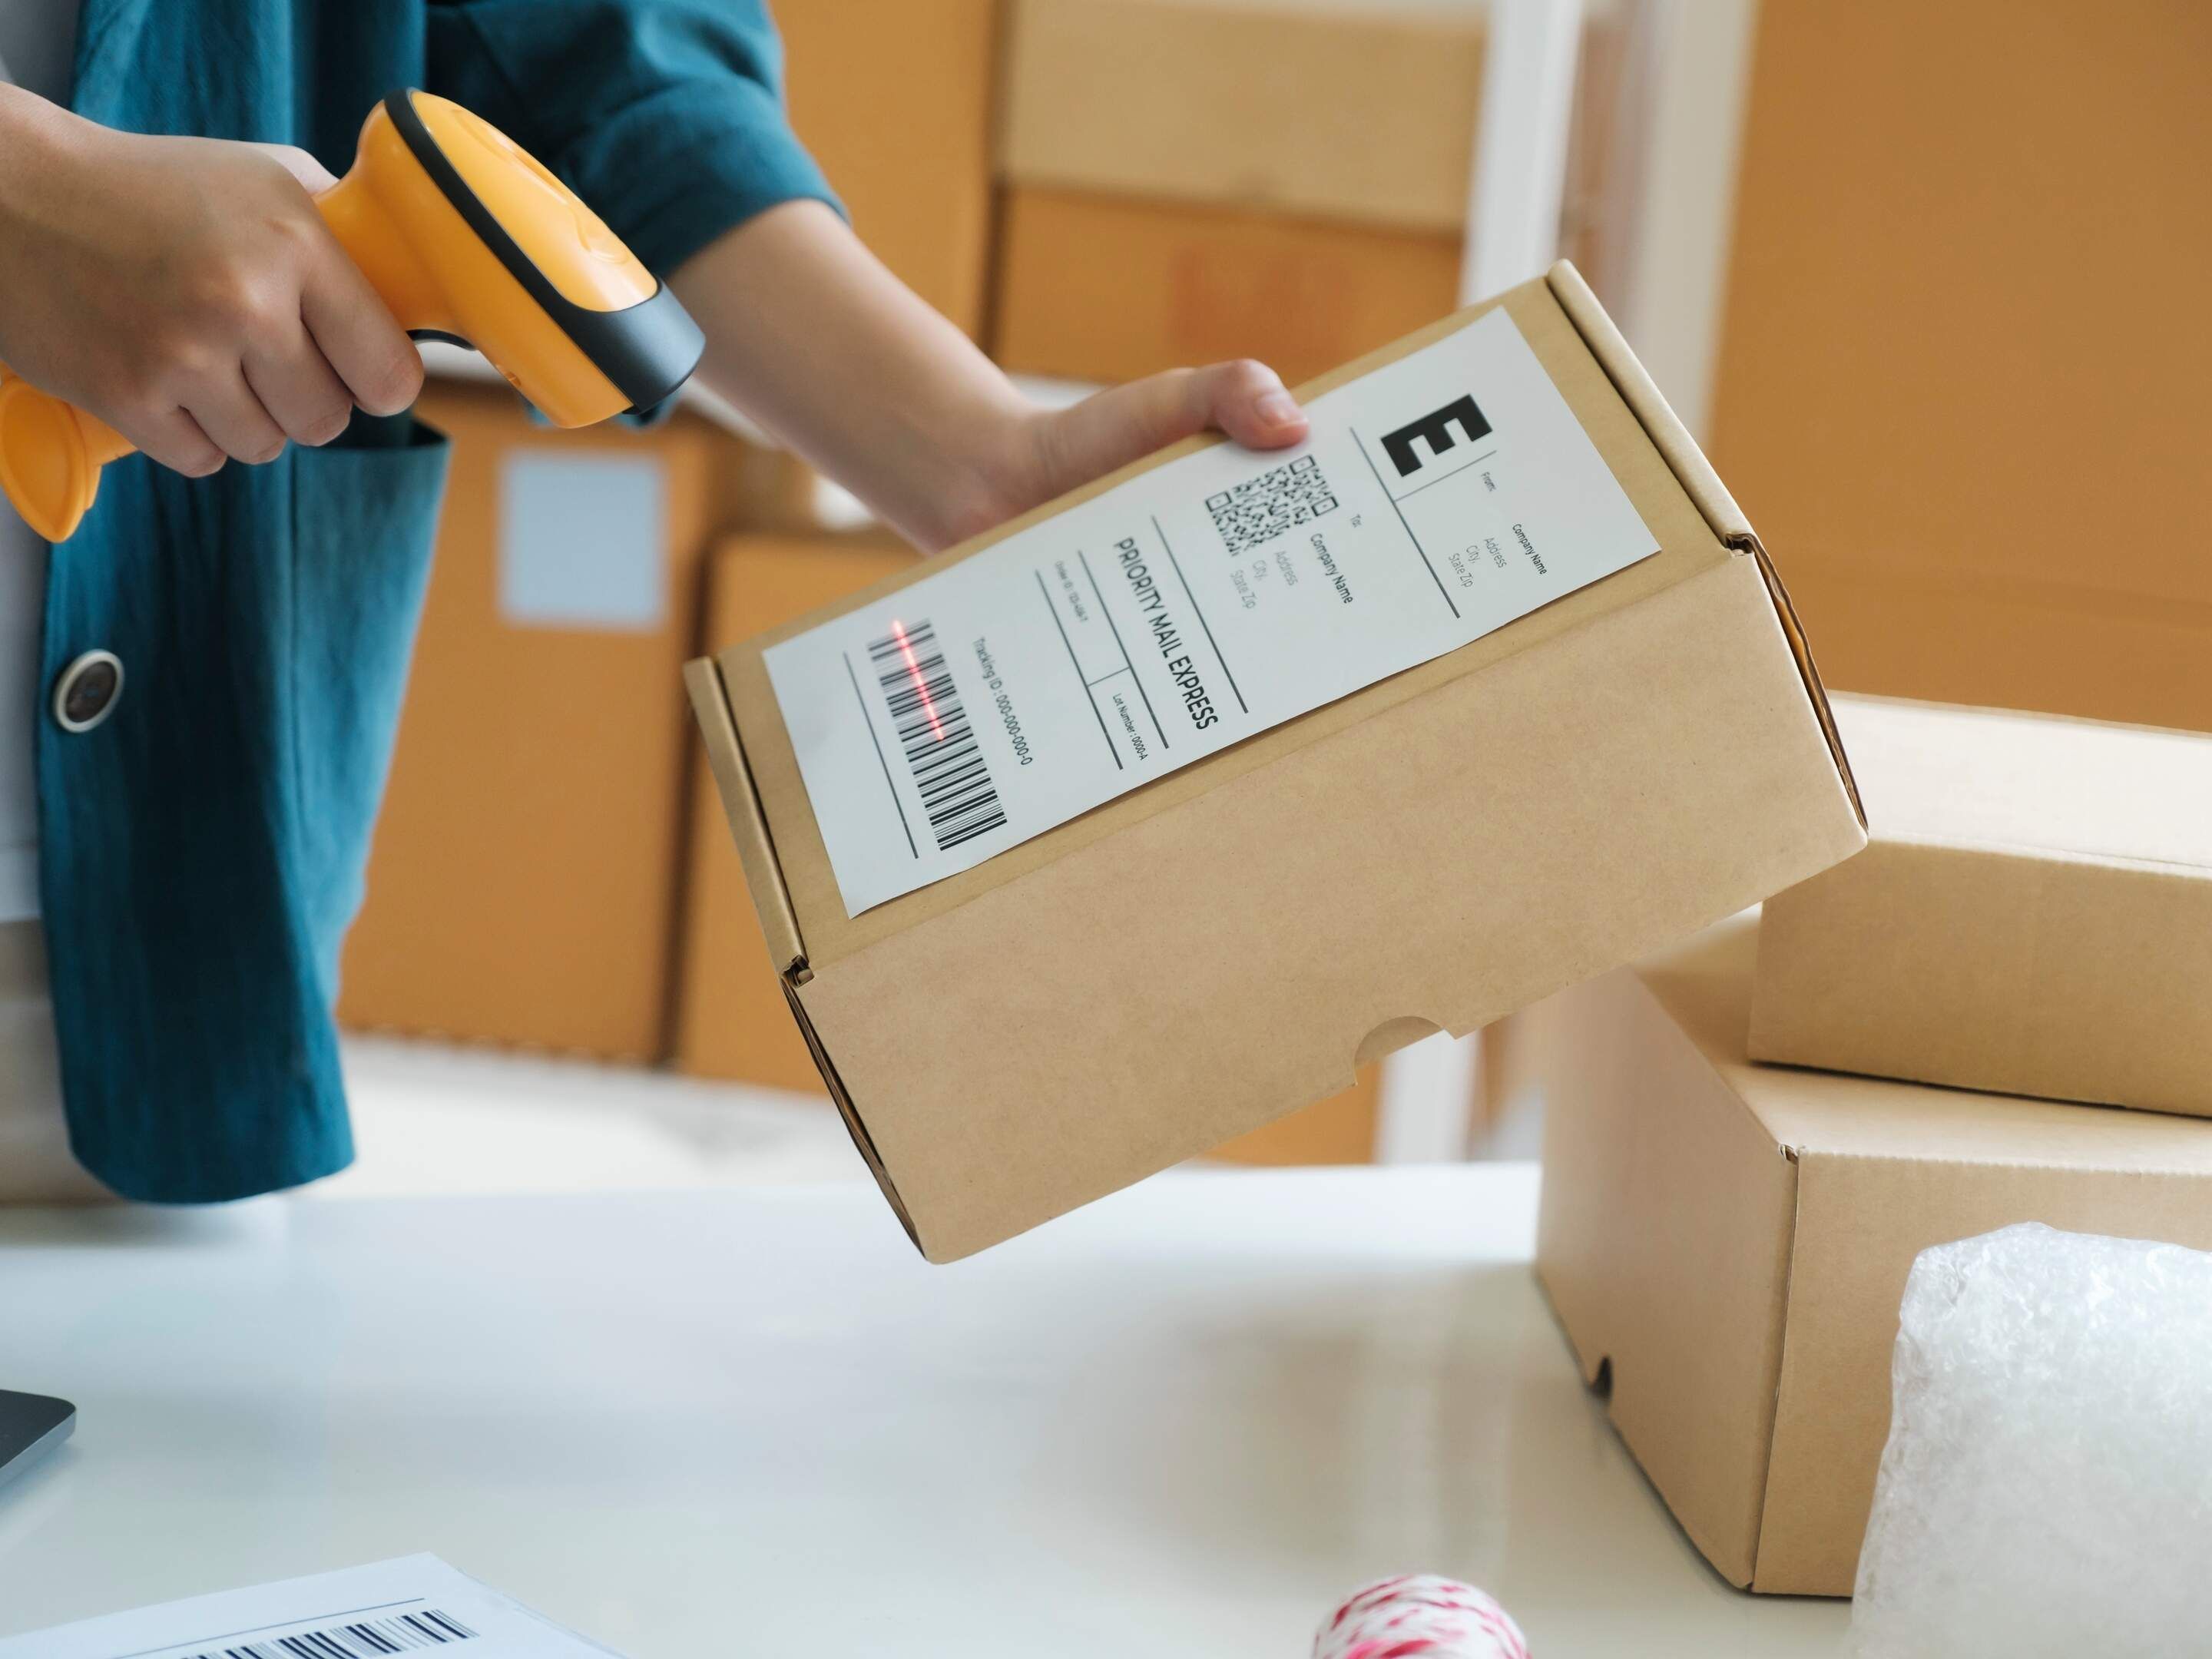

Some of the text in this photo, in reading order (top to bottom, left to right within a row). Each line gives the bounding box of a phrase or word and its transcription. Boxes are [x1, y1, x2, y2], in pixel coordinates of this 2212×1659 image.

[1381, 393, 1492, 477] E
[1484, 538, 1507, 568] Address
[1512, 523, 1548, 575] Company Name
[1274, 551, 1298, 586] Address
[1310, 533, 1353, 604] Company Name
[1449, 553, 1474, 588] State Zip
[1230, 570, 1257, 609] State Zip
[1114, 535, 1218, 730] PRIORITY MAIL EXPRESS
[973, 637, 995, 679] Tracking
[988, 677, 1002, 690] ID
[996, 694, 1033, 765] 000-000-000-0
[1113, 693, 1124, 707] Lot
[1118, 705, 1135, 733] Number
[1131, 736, 1148, 760] 0000-A
